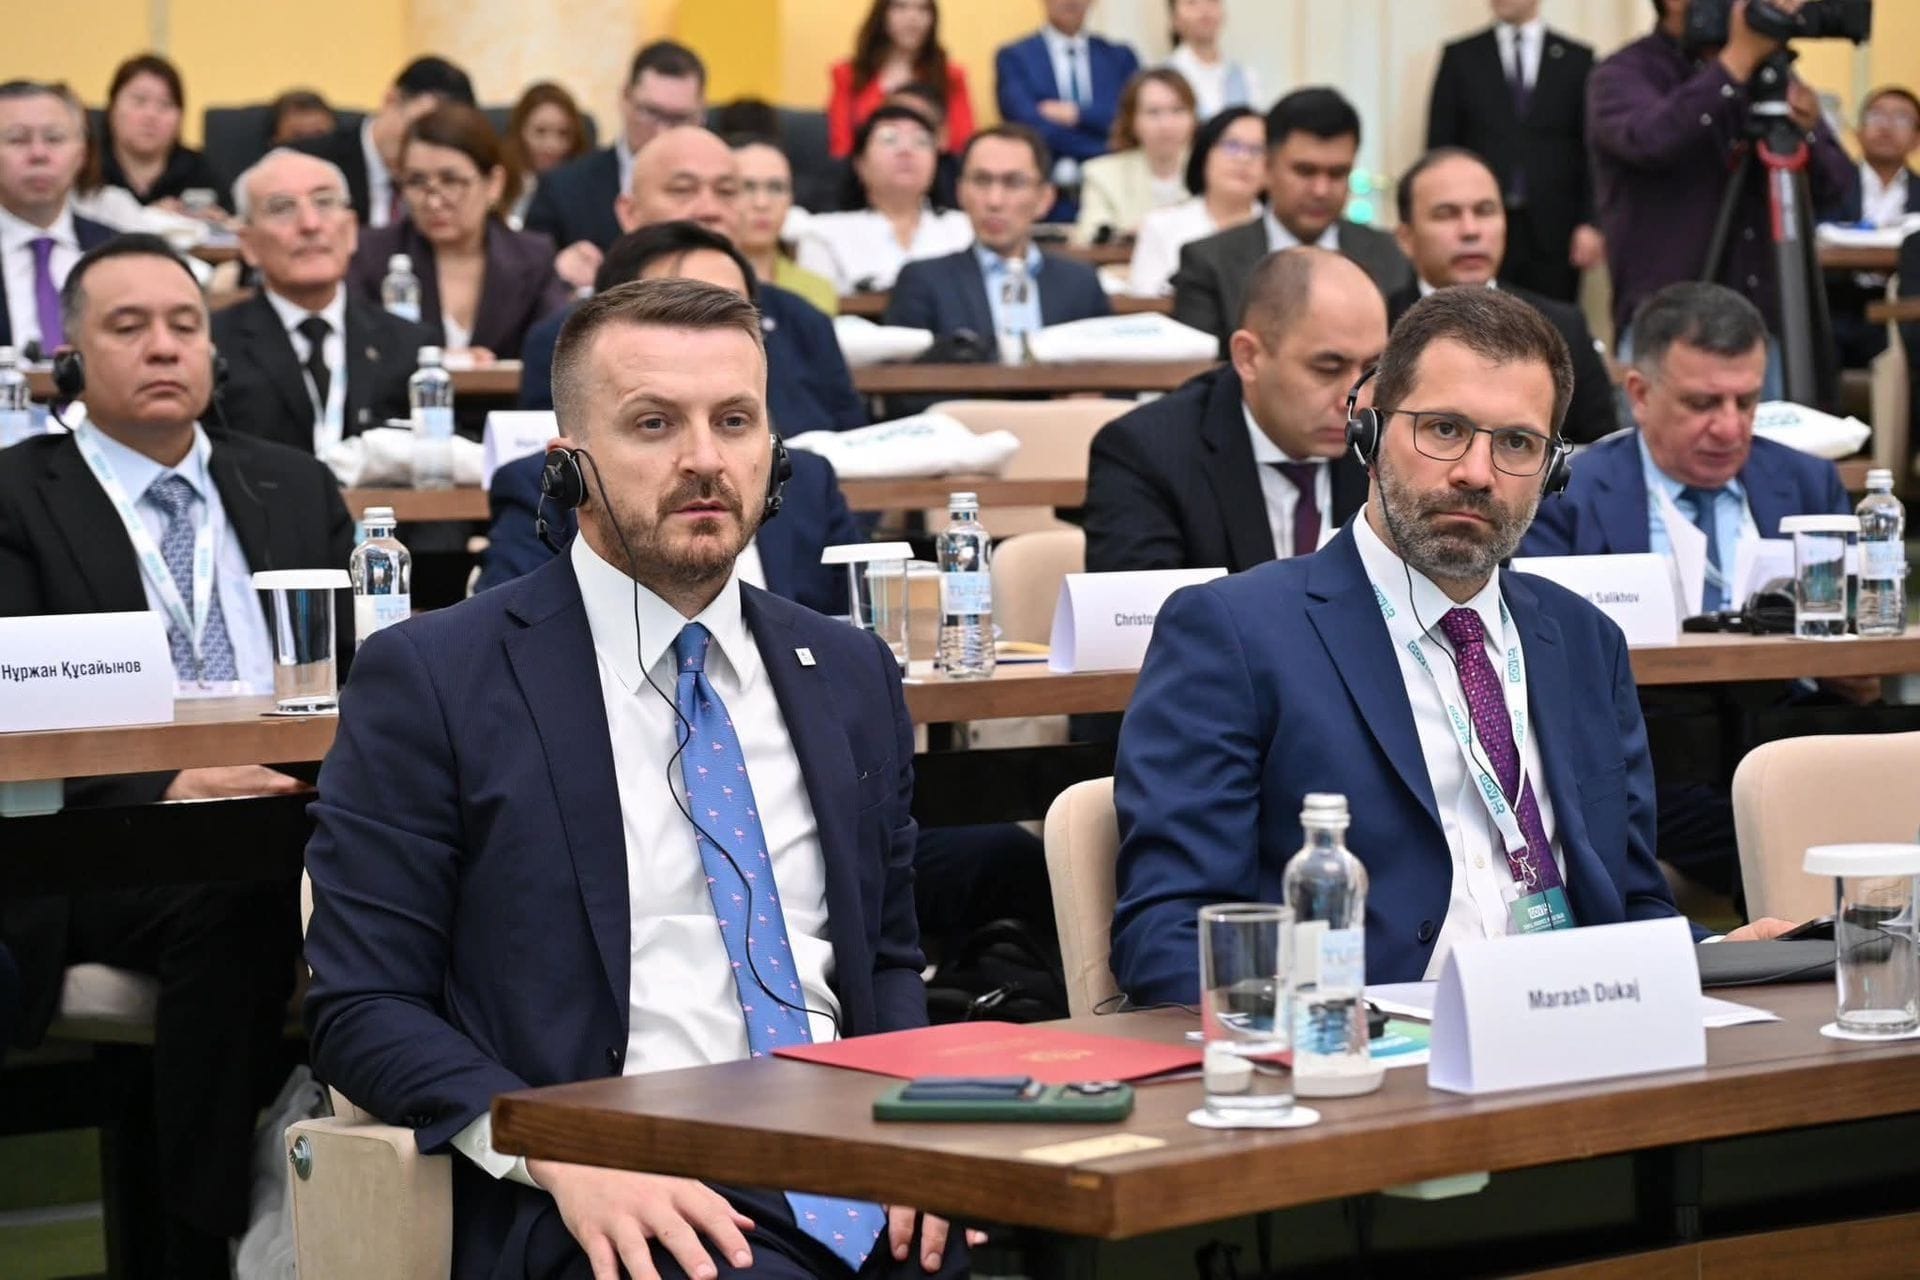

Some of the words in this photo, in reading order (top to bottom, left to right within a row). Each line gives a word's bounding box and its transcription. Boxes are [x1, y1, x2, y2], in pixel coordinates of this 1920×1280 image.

[1115, 613, 1154, 627] Christo
[1, 664, 58, 682] Нұржан
[61, 660, 142, 679] Құсайынов
[1529, 986, 1590, 1010] Marash
[1596, 978, 1641, 1003] Dukaj
